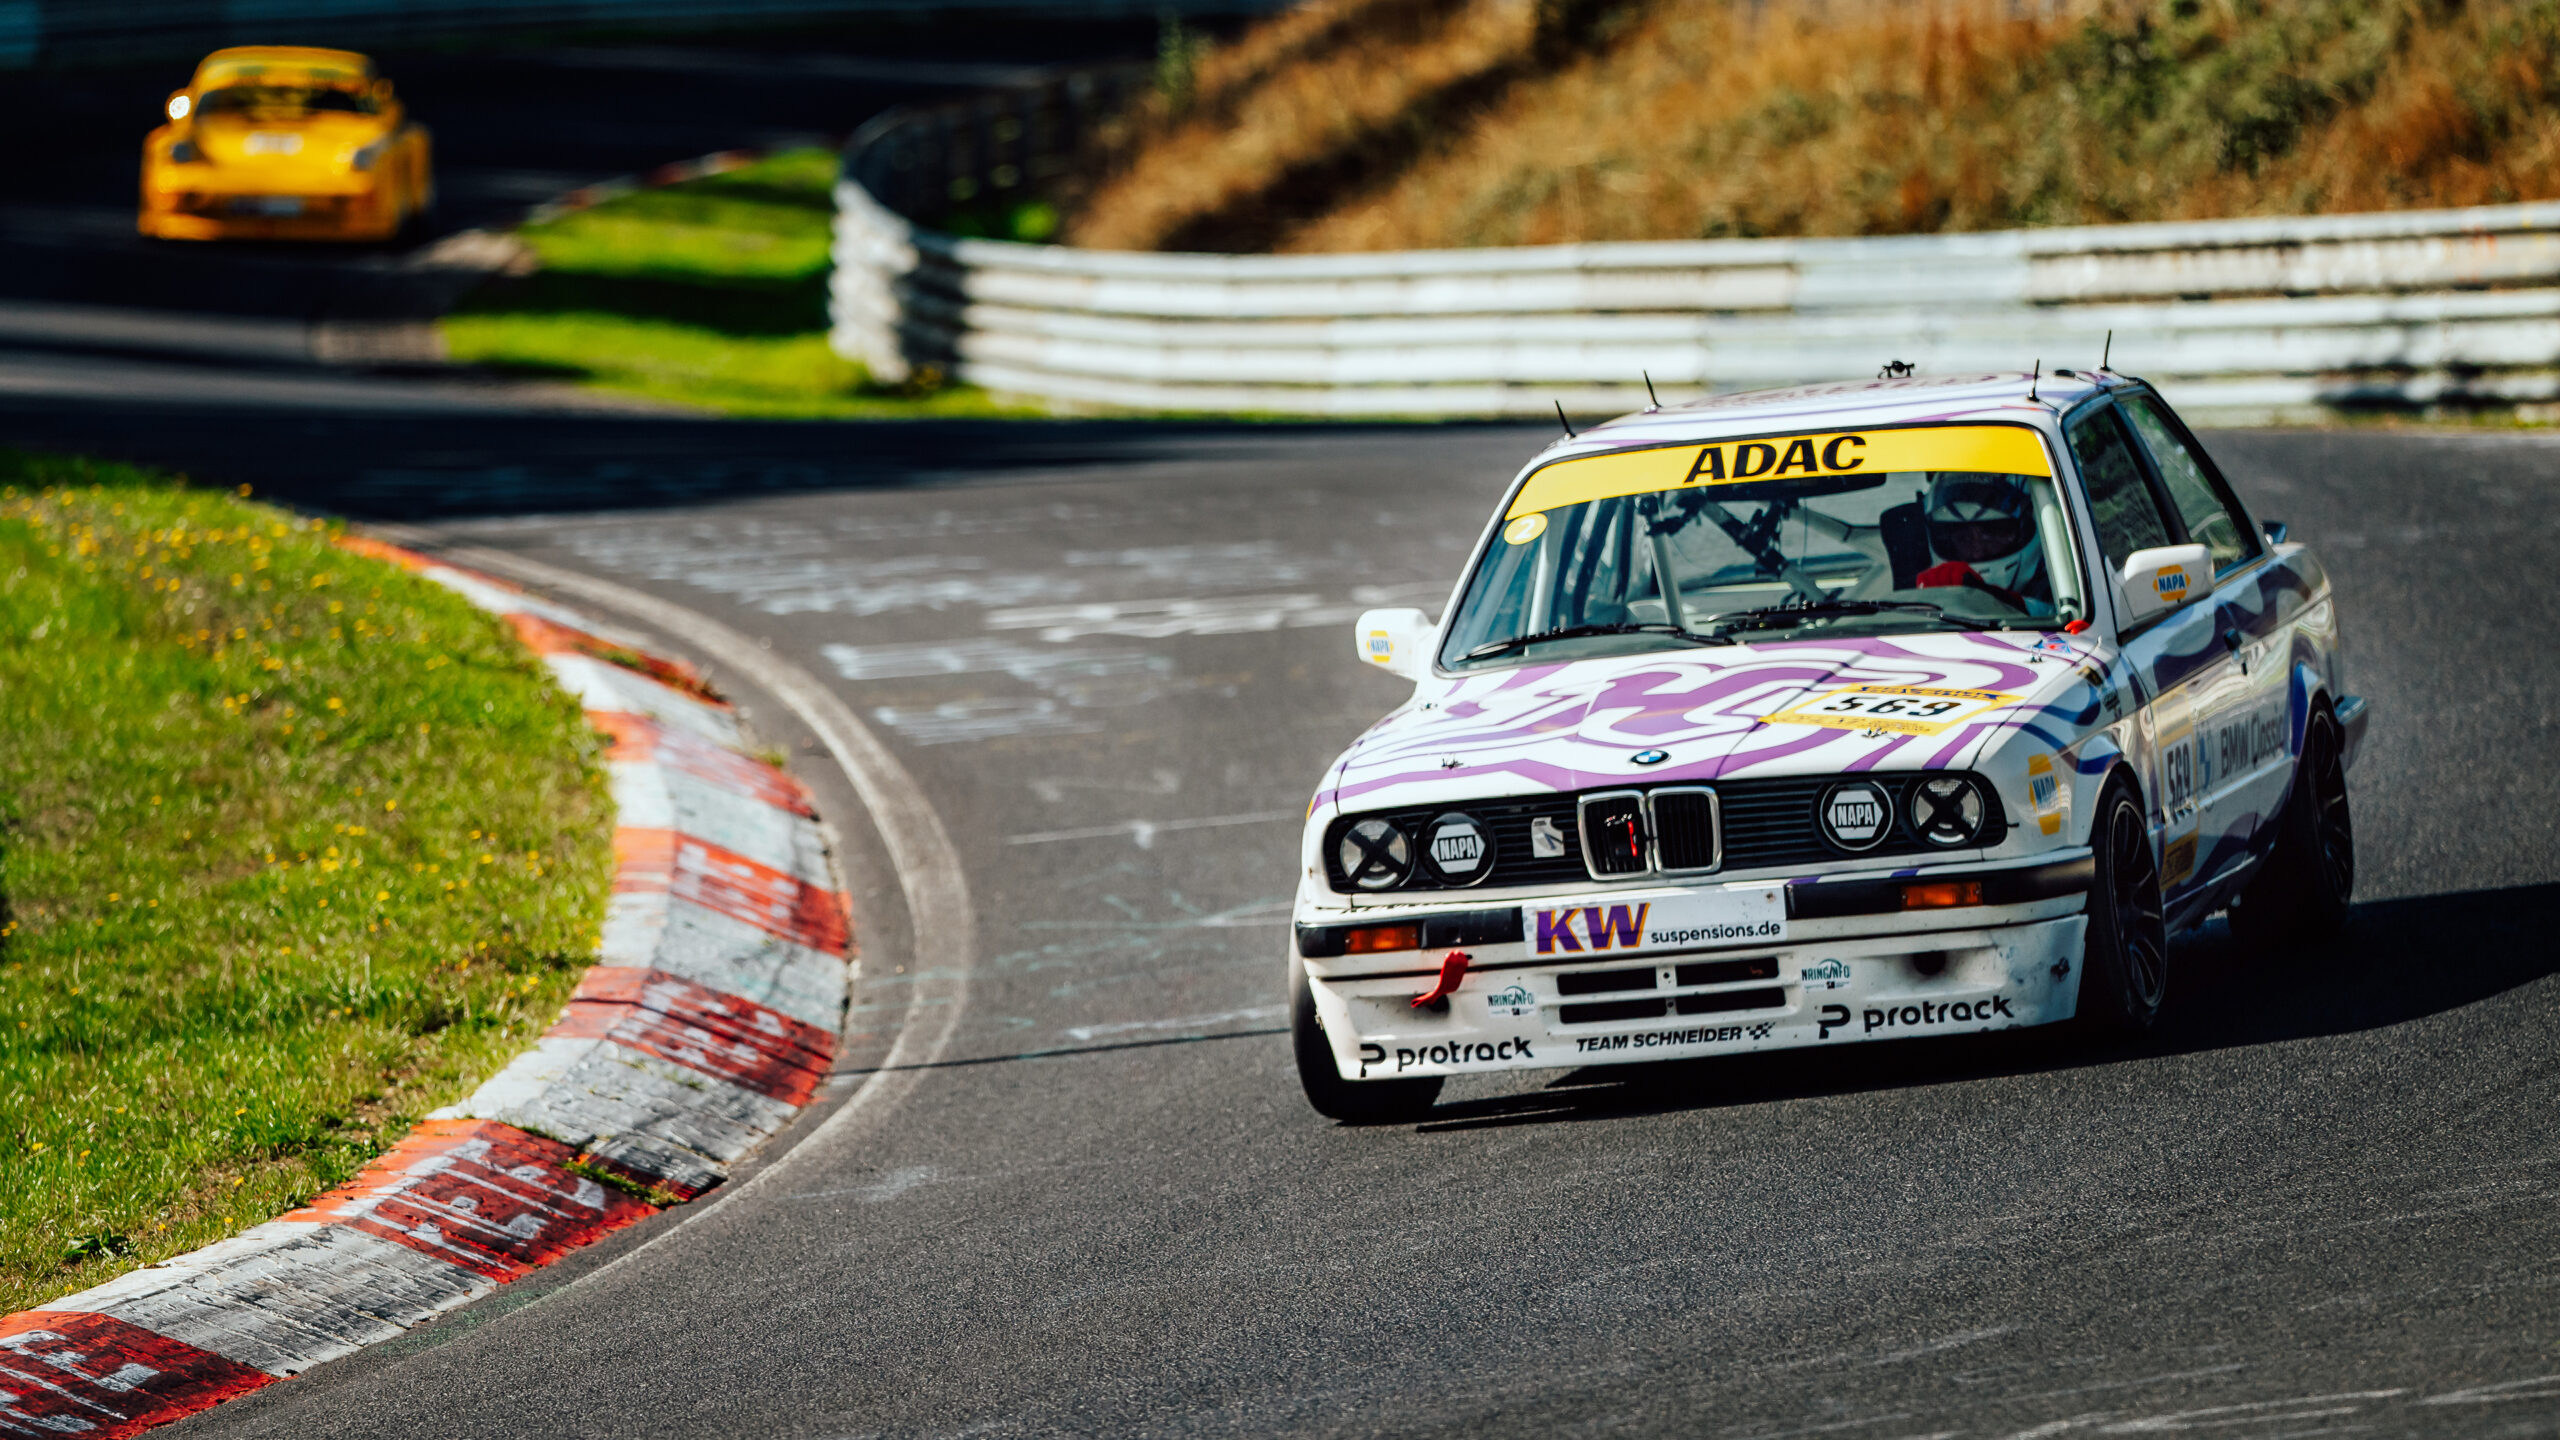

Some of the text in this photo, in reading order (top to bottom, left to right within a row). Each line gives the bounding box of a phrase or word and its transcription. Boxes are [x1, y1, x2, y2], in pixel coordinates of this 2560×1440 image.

[1683, 435, 1867, 484] ADAC
[1514, 518, 1536, 541] 2
[2158, 574, 2186, 592] NAPA
[1823, 696, 1962, 717] 569
[2221, 716, 2249, 778] BMW
[2032, 775, 2058, 808] NAPA
[1837, 803, 1874, 827] NAPA
[1439, 836, 1476, 862] NAPA
[1536, 902, 1651, 955] KW
[1650, 920, 1781, 945] suspensions.de
[1863, 995, 2015, 1034] protrack
[1576, 1026, 1743, 1053] TEAM SCHNEIDER
[1396, 1036, 1534, 1073] protrack
